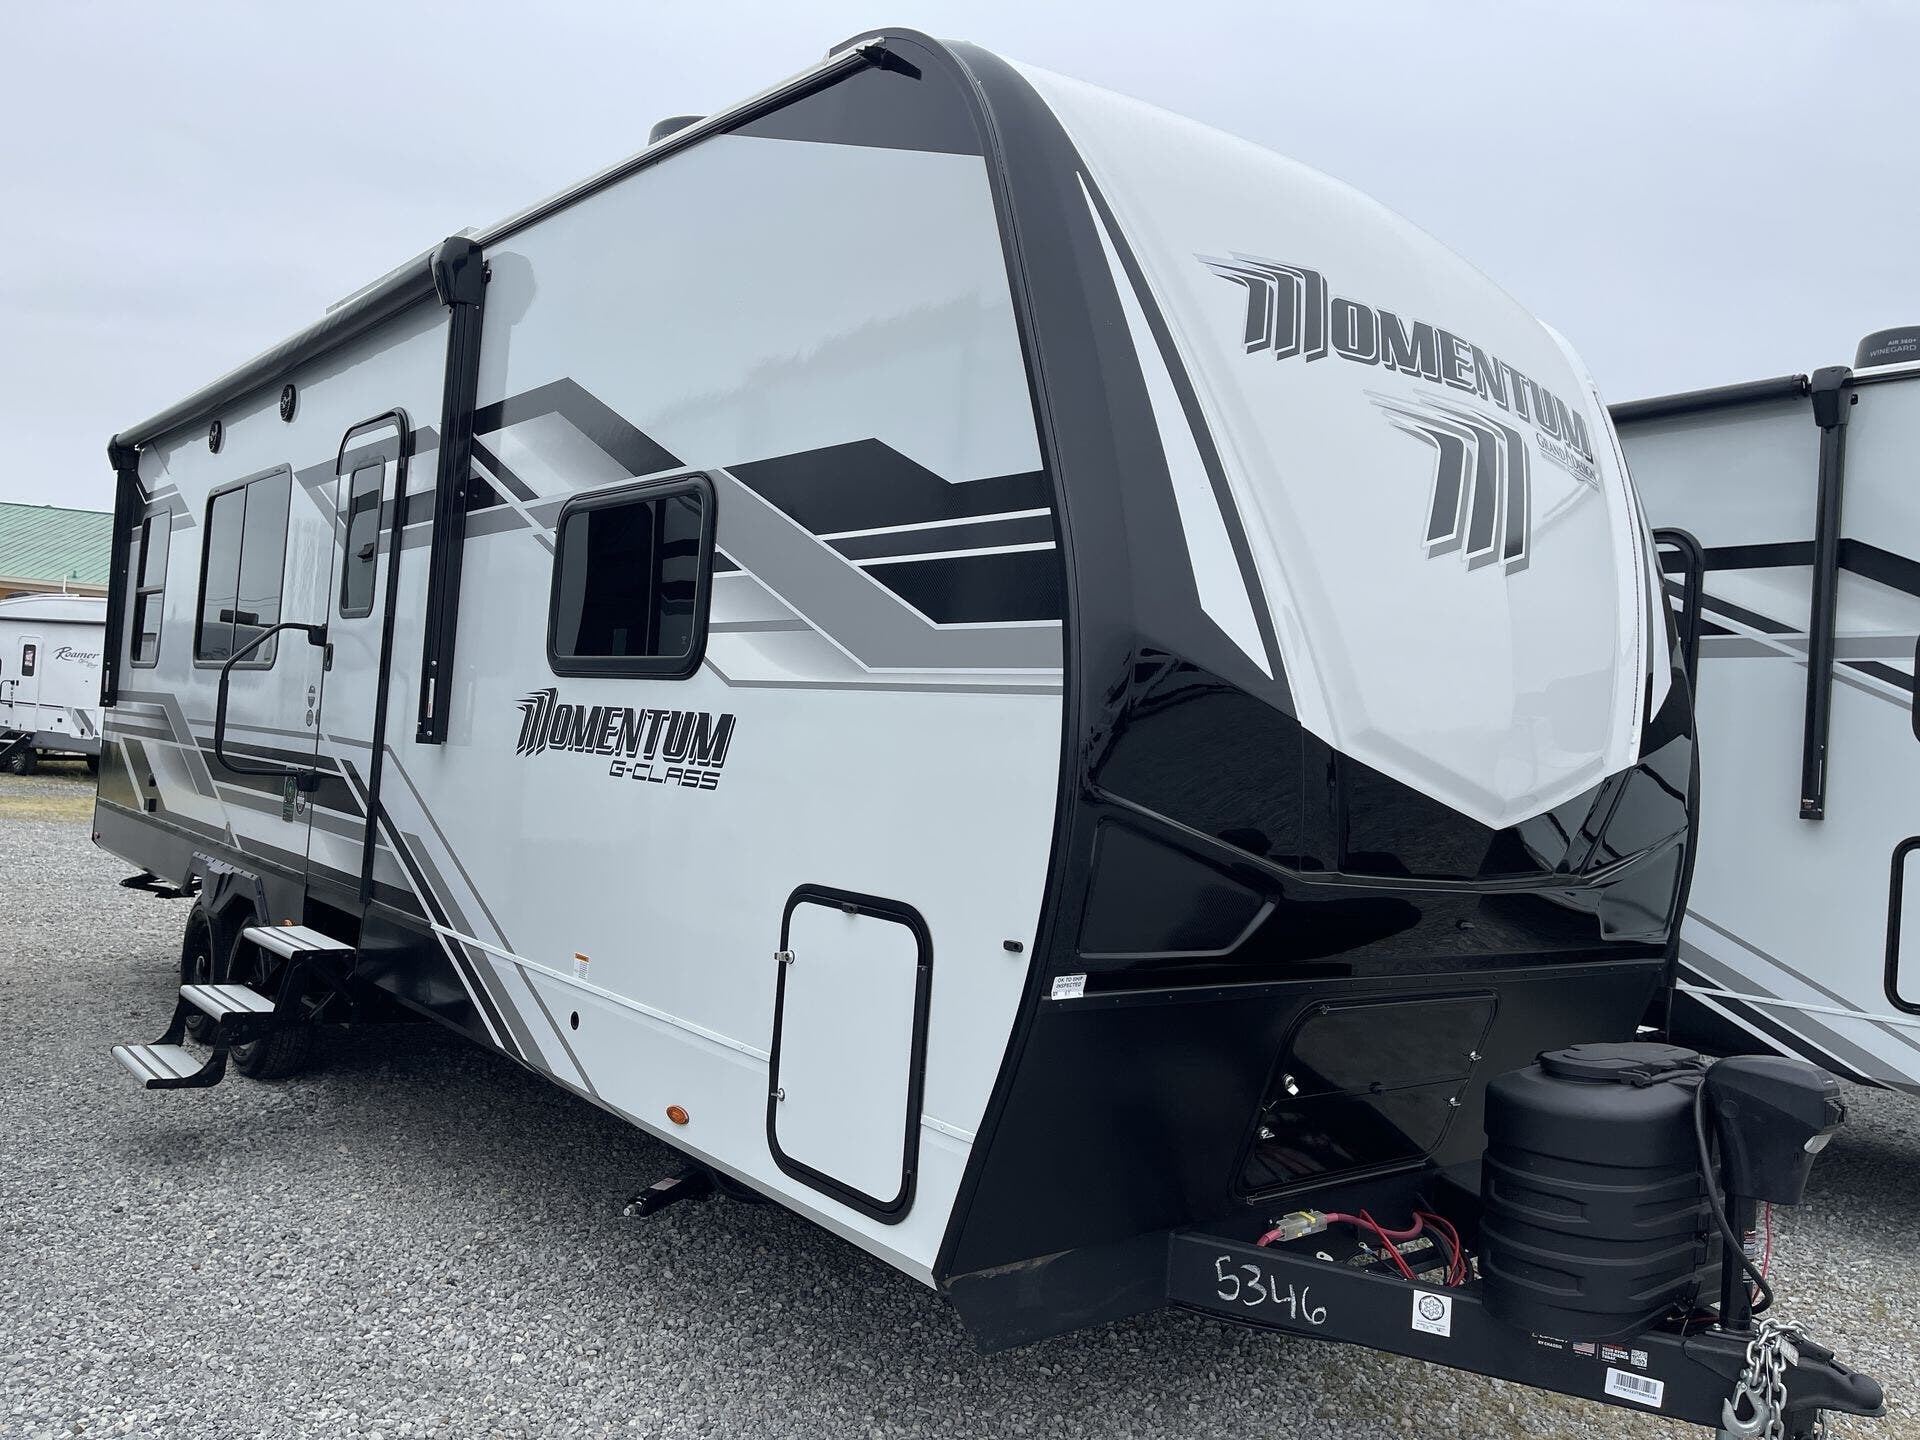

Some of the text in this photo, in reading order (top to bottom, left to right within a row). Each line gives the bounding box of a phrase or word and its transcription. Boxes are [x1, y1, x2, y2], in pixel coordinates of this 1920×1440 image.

[1193, 251, 1594, 464] MOMENTUM
[1870, 344, 1917, 357] WINEGARD
[53, 646, 100, 662] Roamer
[512, 687, 736, 769] MOMENTUM
[608, 760, 721, 791] G-CLASS
[1215, 1254, 1327, 1326] 5346
